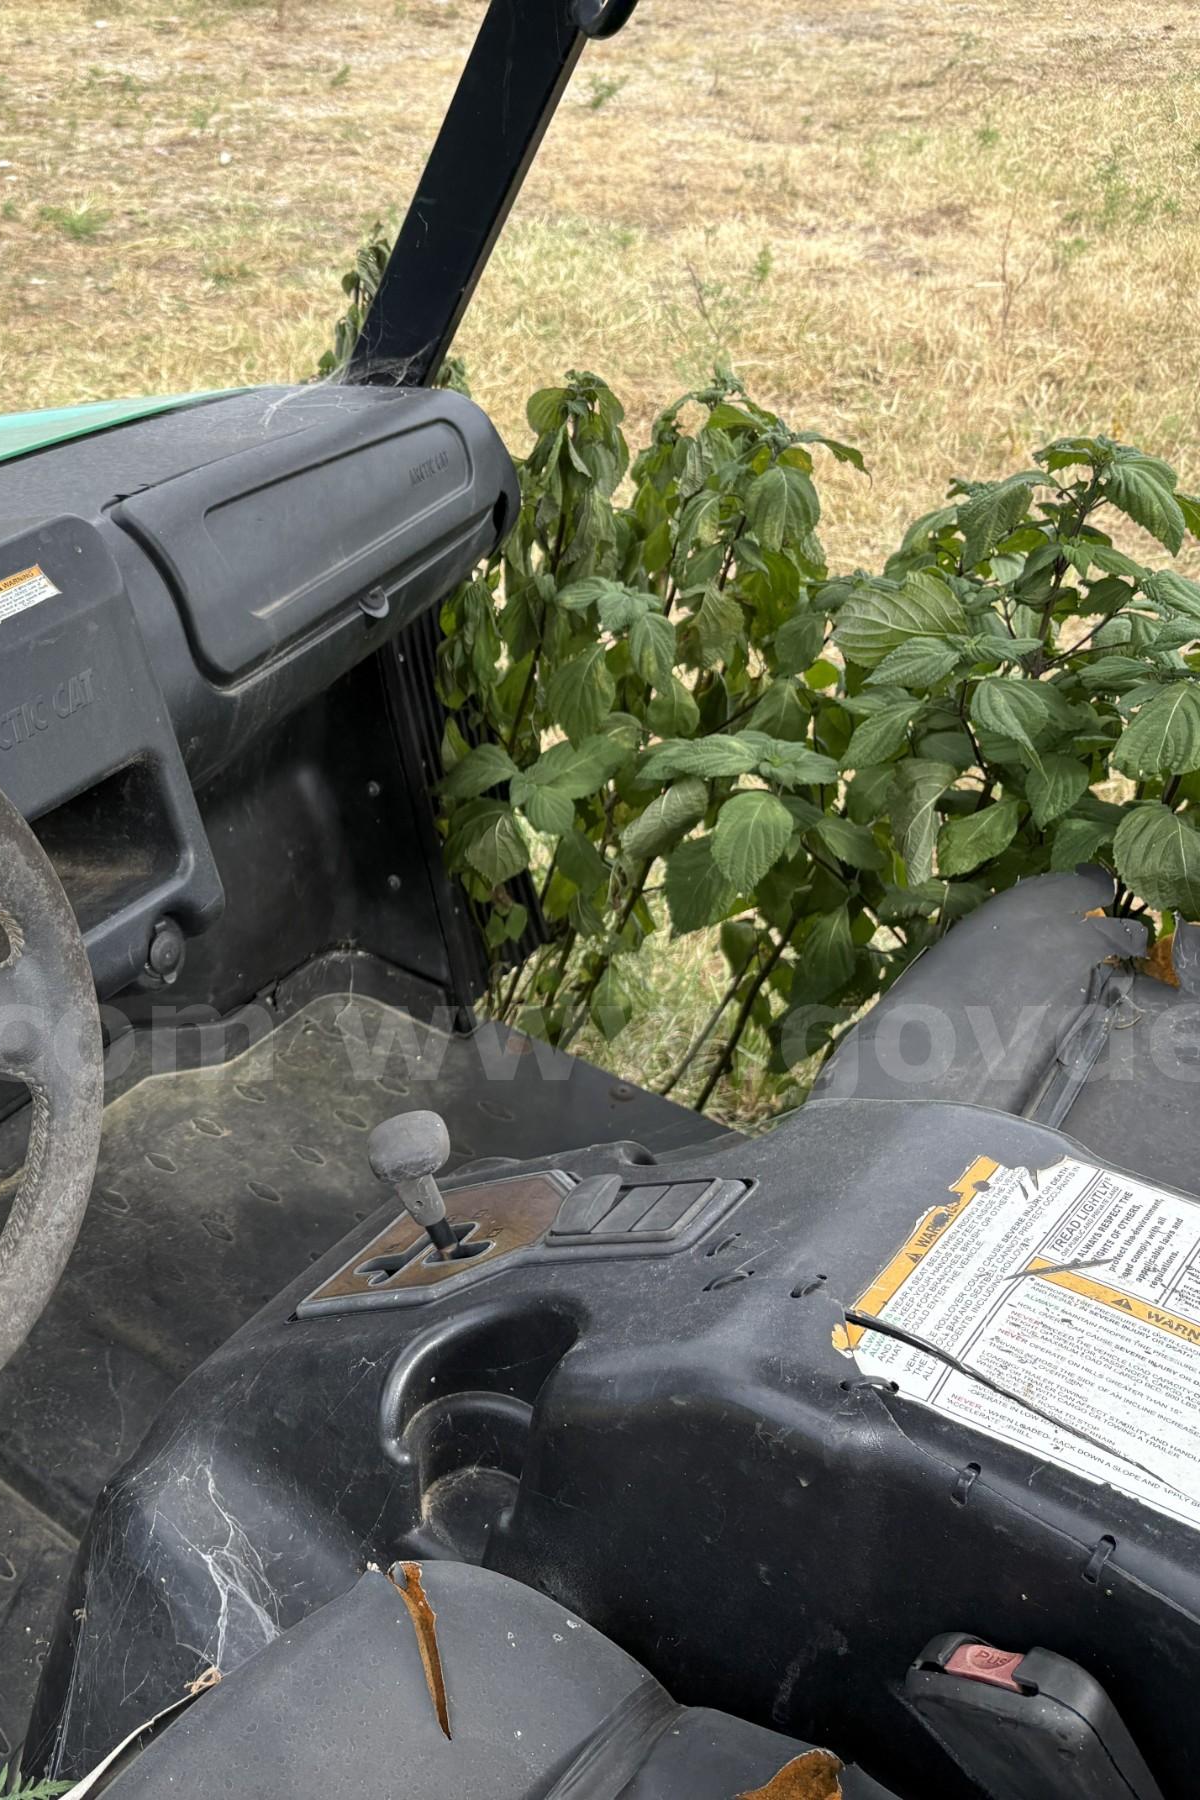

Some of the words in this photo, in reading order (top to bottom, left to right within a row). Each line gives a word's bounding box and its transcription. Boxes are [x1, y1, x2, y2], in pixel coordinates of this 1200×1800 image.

[897, 1296, 917, 1316] KEEP
[912, 1275, 934, 1297] YOUR
[929, 1251, 952, 1276] HANDS
[948, 1236, 965, 1251] AND
[960, 1219, 979, 1236] FEET
[974, 1198, 996, 1220] INSIDE
[992, 1185, 1006, 1198] THE
[915, 1291, 932, 1308] FOR
[988, 1194, 1009, 1216] OTHER
[1049, 1219, 1082, 1253] TREAD
[1075, 1179, 1113, 1220] LIGHTLY!
[1076, 1231, 1102, 1258] ALWAYS
[1097, 1203, 1124, 1232] RESPECT
[1118, 1190, 1133, 1205] THE
[1109, 1228, 1122, 1239] OF
[1128, 1238, 1152, 1263] comply
[1144, 1224, 1160, 1239] with
[1159, 1229, 1175, 1245] laws
[1169, 1216, 1184, 1229] and
[888, 1290, 910, 1313] WEAR
[910, 1266, 929, 1285] SEAT
[925, 1249, 943, 1266] BELT
[938, 1228, 960, 1250] WHEN
[956, 1206, 979, 1229] RIDING
[932, 1291, 967, 1331] ROLLOVER
[981, 1242, 1004, 1267] CAUSE
[1000, 1216, 1026, 1243] SEVERE
[1022, 1194, 1044, 1216] INJURY
[945, 1315, 961, 1331] BAR
[956, 1298, 974, 1315] AND
[969, 1263, 999, 1298] SEATBELT
[995, 1235, 1021, 1264] CANNOT
[1017, 1205, 1046, 1236] PROTECT
[970, 1274, 1004, 1313] INCLUDING
[1106, 1245, 1128, 1272] protect
[885, 1344, 902, 1364] THAT
[907, 1309, 930, 1334] COULD
[926, 1284, 949, 1309] ENTER
[945, 1269, 960, 1284] THE
[956, 1240, 983, 1269] VEHICLE
[974, 1650, 1015, 1666] PUS
